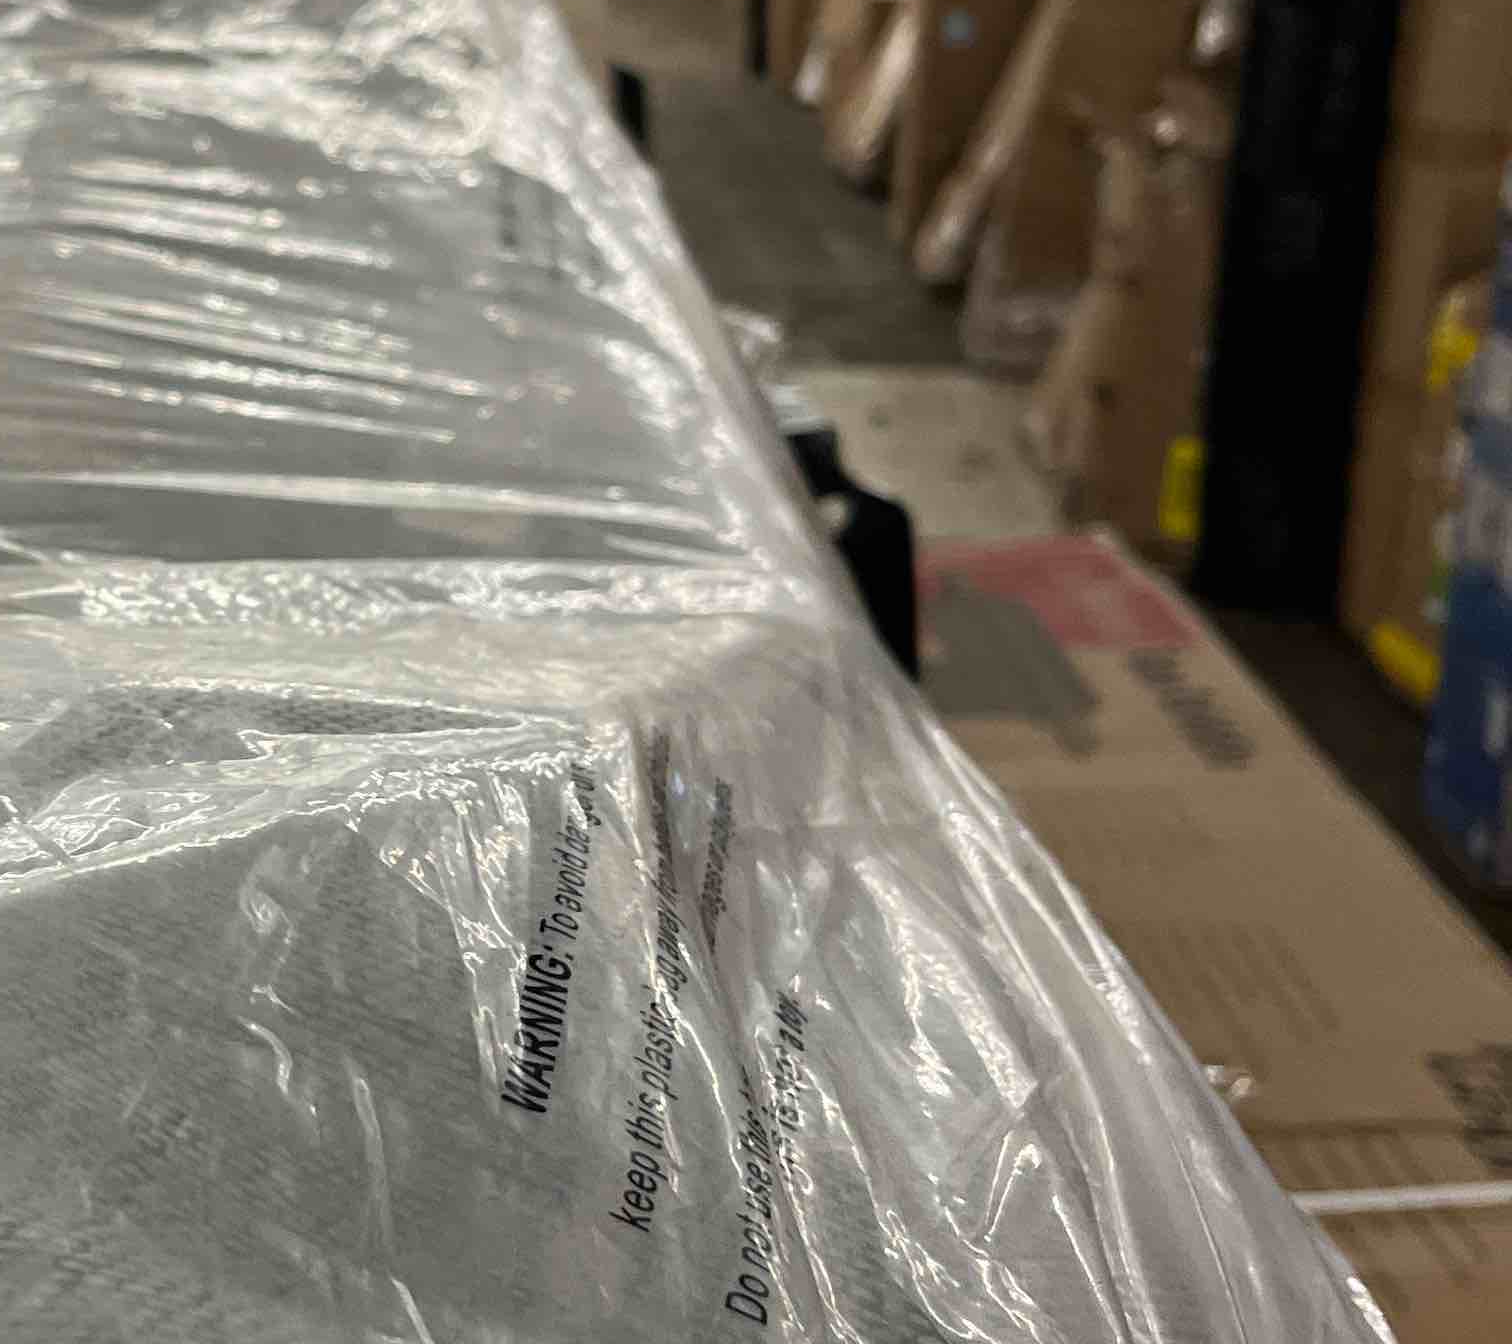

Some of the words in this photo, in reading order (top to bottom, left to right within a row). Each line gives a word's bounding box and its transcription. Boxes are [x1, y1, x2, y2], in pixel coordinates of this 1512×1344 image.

[551, 846, 589, 913] avoid
[539, 911, 579, 941] To
[501, 942, 575, 1115] WARNING:
[625, 1094, 665, 1150] this
[609, 1152, 668, 1233] keep
[744, 1160, 774, 1219] use
[736, 1212, 773, 1266] not
[724, 1272, 771, 1326] Do
